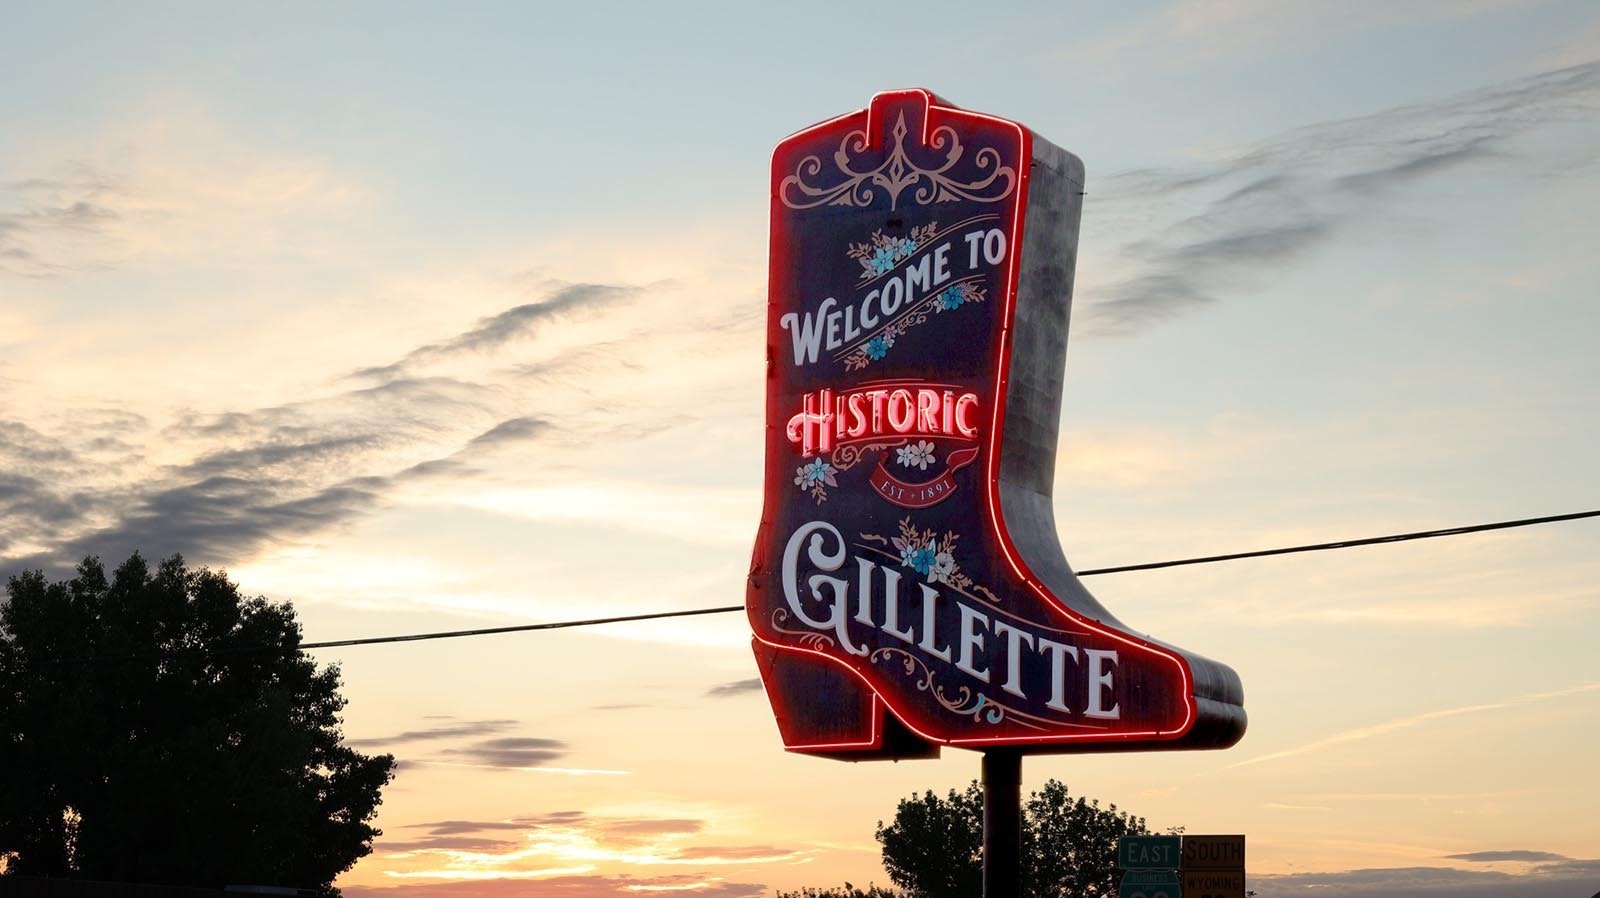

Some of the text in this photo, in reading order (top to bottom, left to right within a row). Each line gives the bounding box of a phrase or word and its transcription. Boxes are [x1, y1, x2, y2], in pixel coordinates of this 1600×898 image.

[780, 228, 1007, 365] WELCOME TO
[786, 388, 979, 458] HISTORIC
[881, 480, 951, 500] EST 1891
[782, 520, 1121, 720] GILLETTE
[1128, 842, 1171, 863] EAST
[1186, 840, 1241, 861] SOUTH
[1188, 877, 1240, 889] WYOMING
